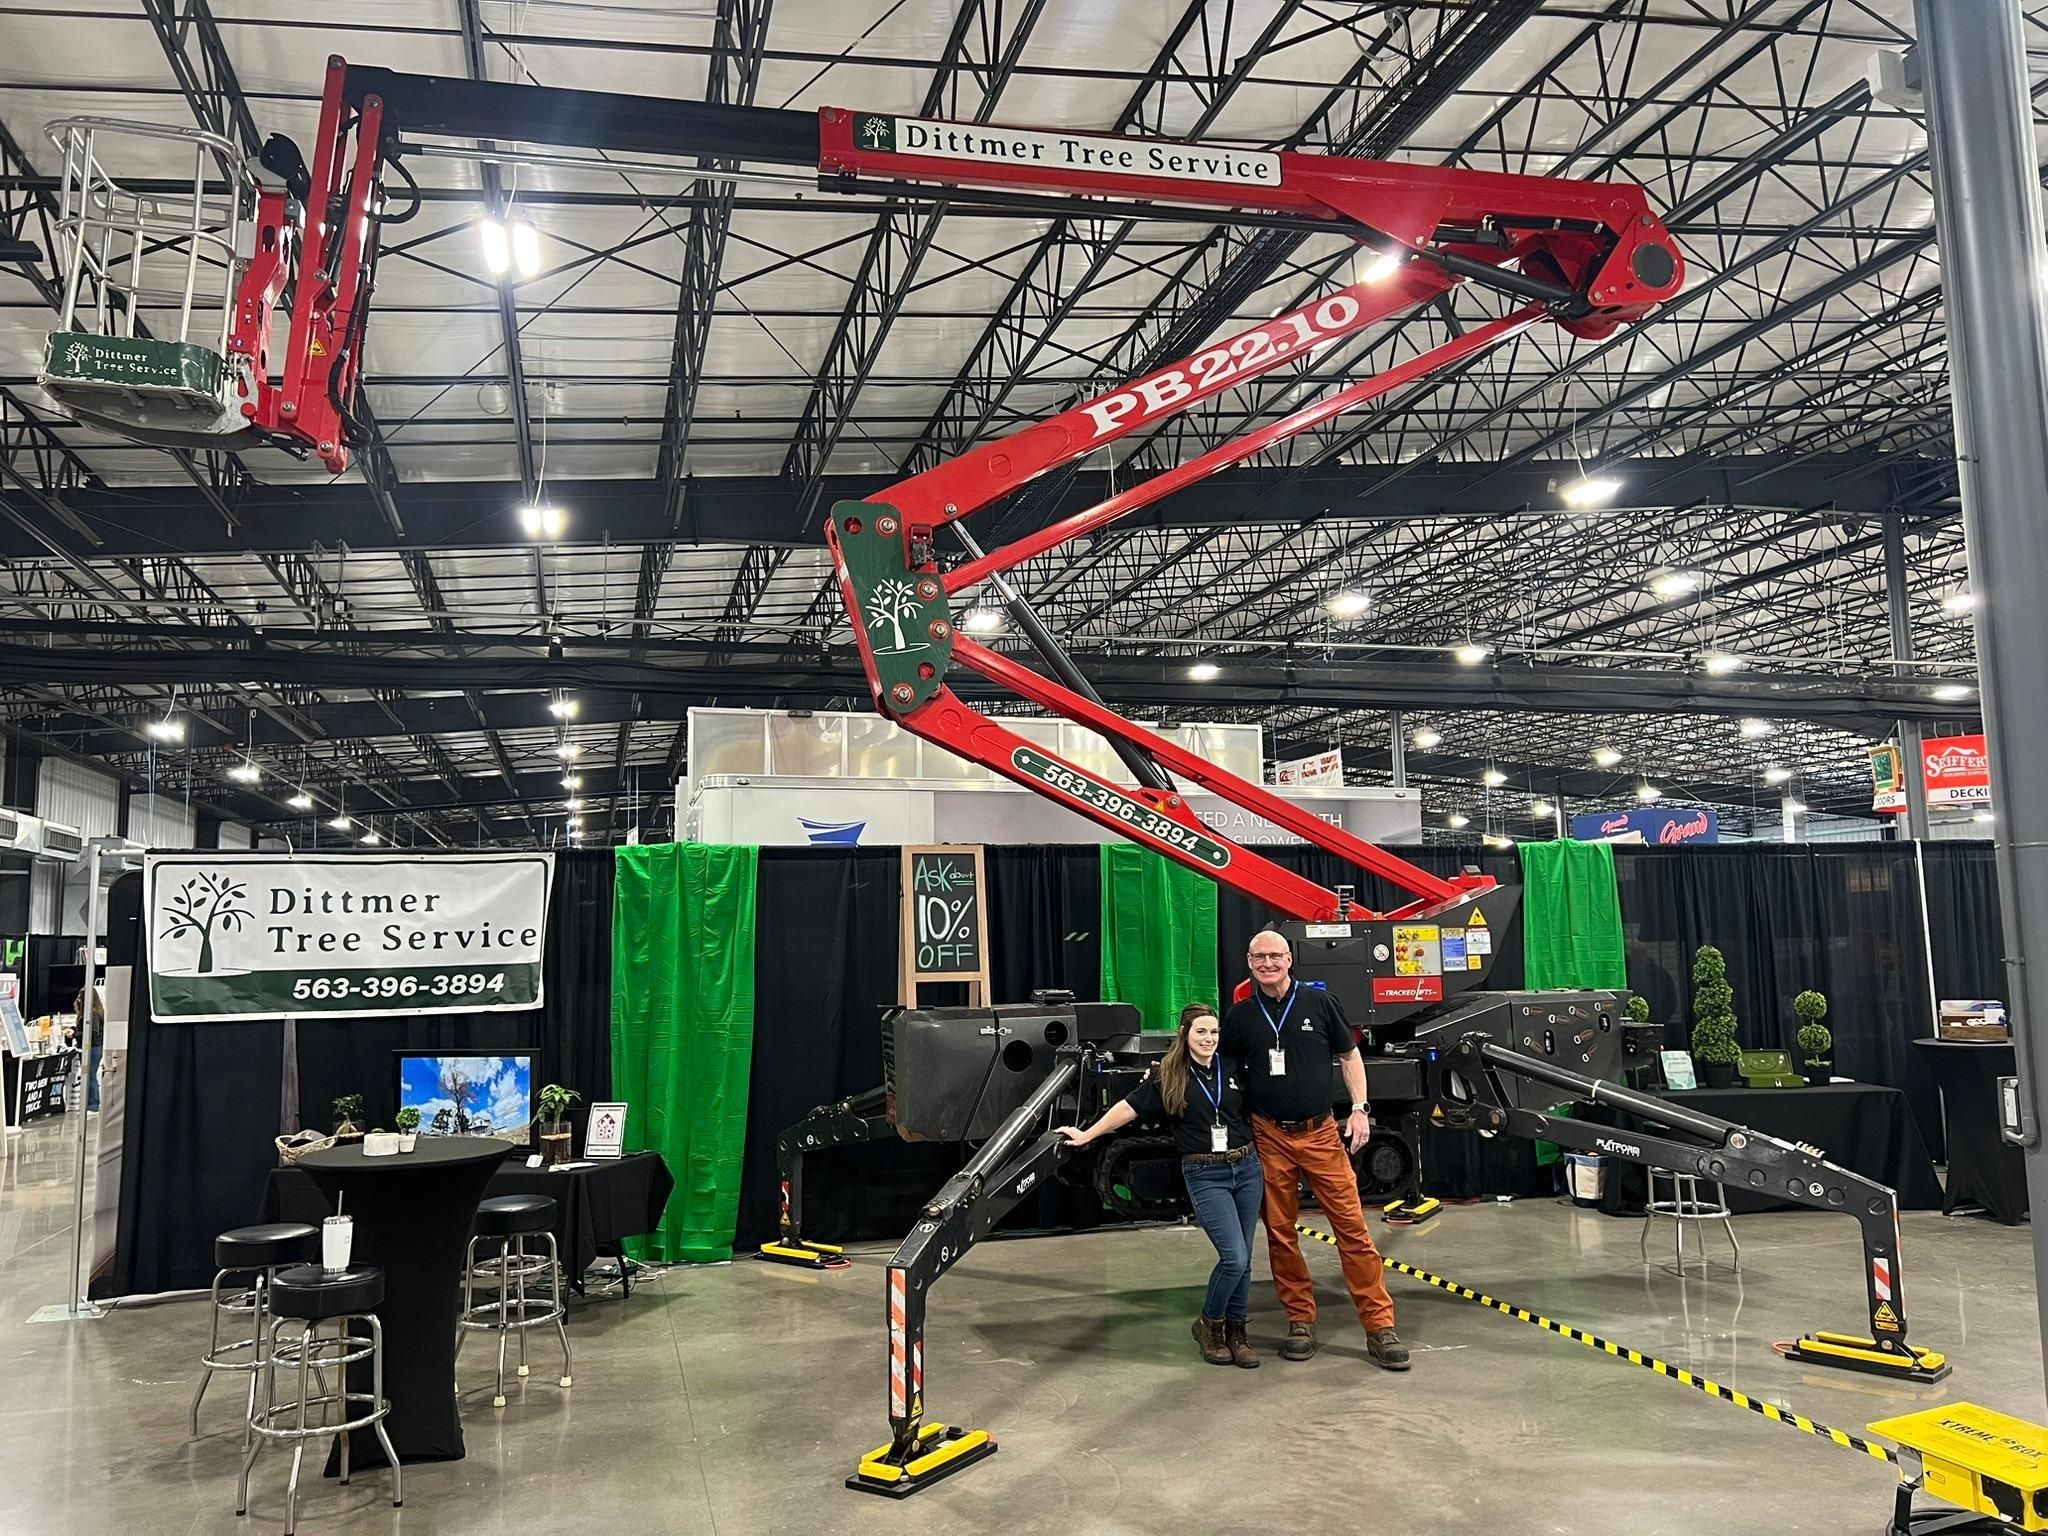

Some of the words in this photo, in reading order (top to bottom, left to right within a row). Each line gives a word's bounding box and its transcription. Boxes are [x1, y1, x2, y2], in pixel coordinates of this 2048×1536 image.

[906, 125, 1045, 161] Dittmer
[1060, 140, 1133, 167] Tree
[1149, 148, 1269, 180] Service
[95, 349, 148, 362] Dittmer
[95, 360, 123, 372] Tree
[130, 363, 177, 376] Service
[1080, 296, 1360, 438] PB22.10
[1926, 754, 1989, 778] SEIFFER
[1043, 764, 1200, 851] 563-396-3894
[1232, 812, 1246, 827] A
[1251, 812, 1275, 828] NE
[950, 868, 974, 879] about
[269, 887, 441, 915] Dittmer
[918, 894, 974, 943] 10%
[267, 925, 361, 954] Tree
[382, 922, 538, 952] Service
[918, 944, 973, 969] OFF
[293, 972, 505, 1000] 563-396-3894
[1596, 1138, 1641, 1157] PLATFORM
